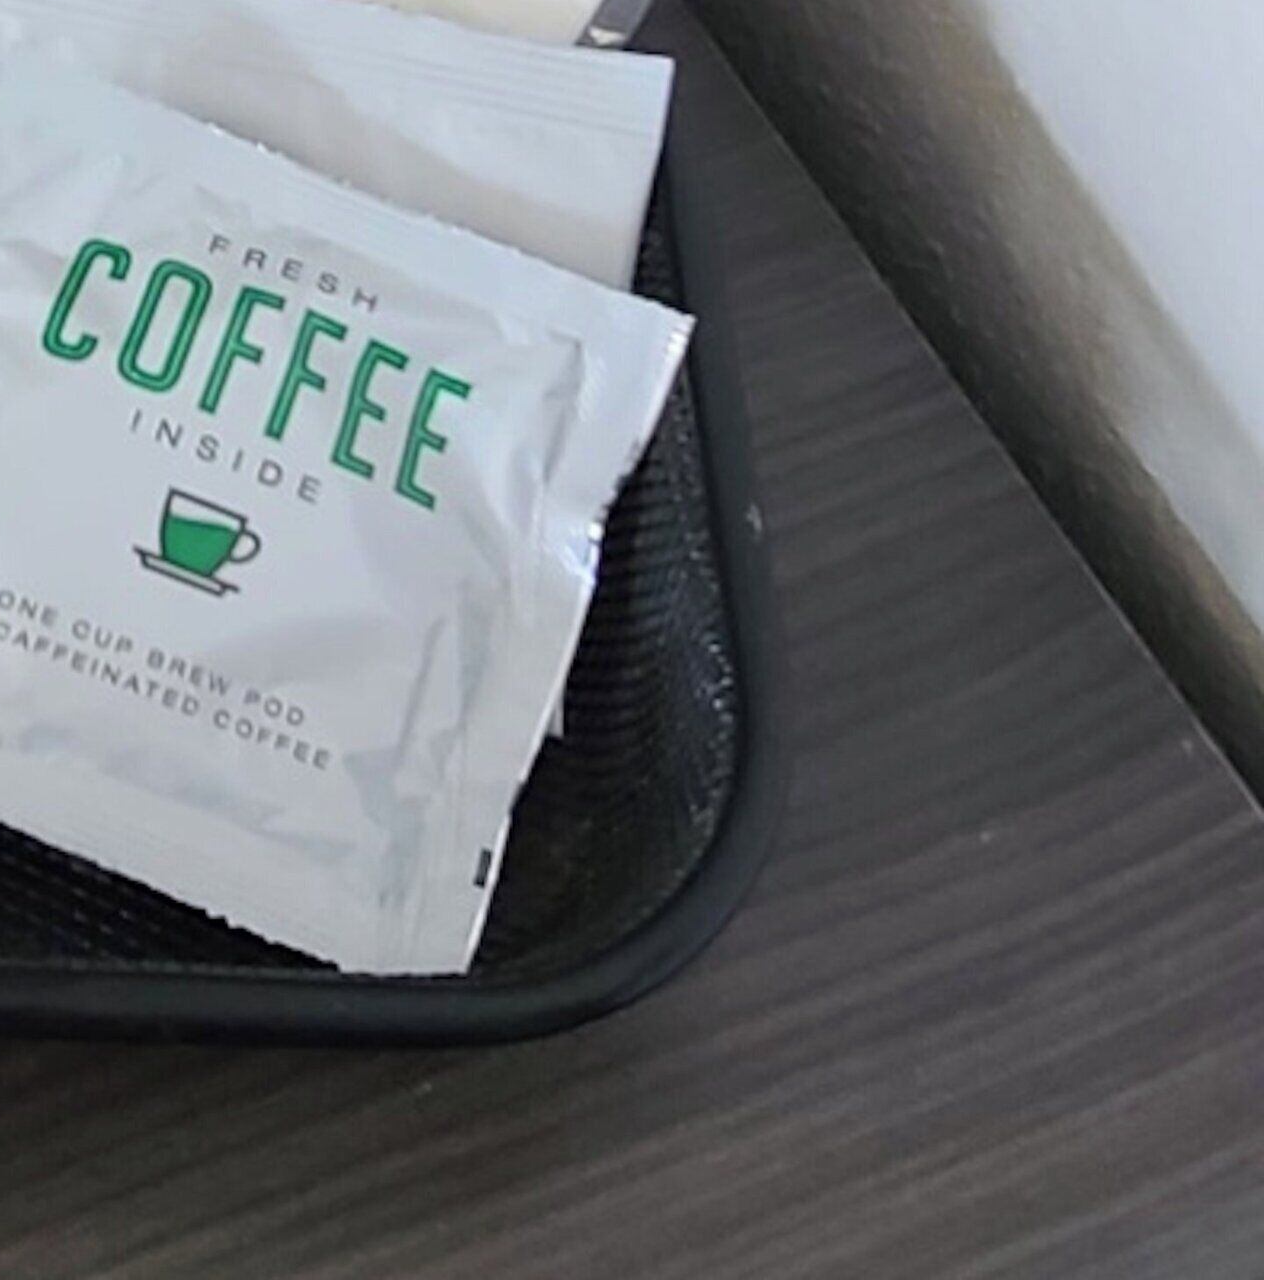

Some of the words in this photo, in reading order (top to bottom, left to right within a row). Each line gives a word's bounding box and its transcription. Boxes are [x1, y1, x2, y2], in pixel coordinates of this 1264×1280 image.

[207, 234, 379, 312] FRESH
[41, 238, 474, 512] COFFEE
[130, 409, 323, 505] INSIDE
[71, 619, 134, 654] CUP
[146, 647, 233, 697] BREW
[243, 688, 306, 727] POD
[212, 708, 332, 771] COFFEE
